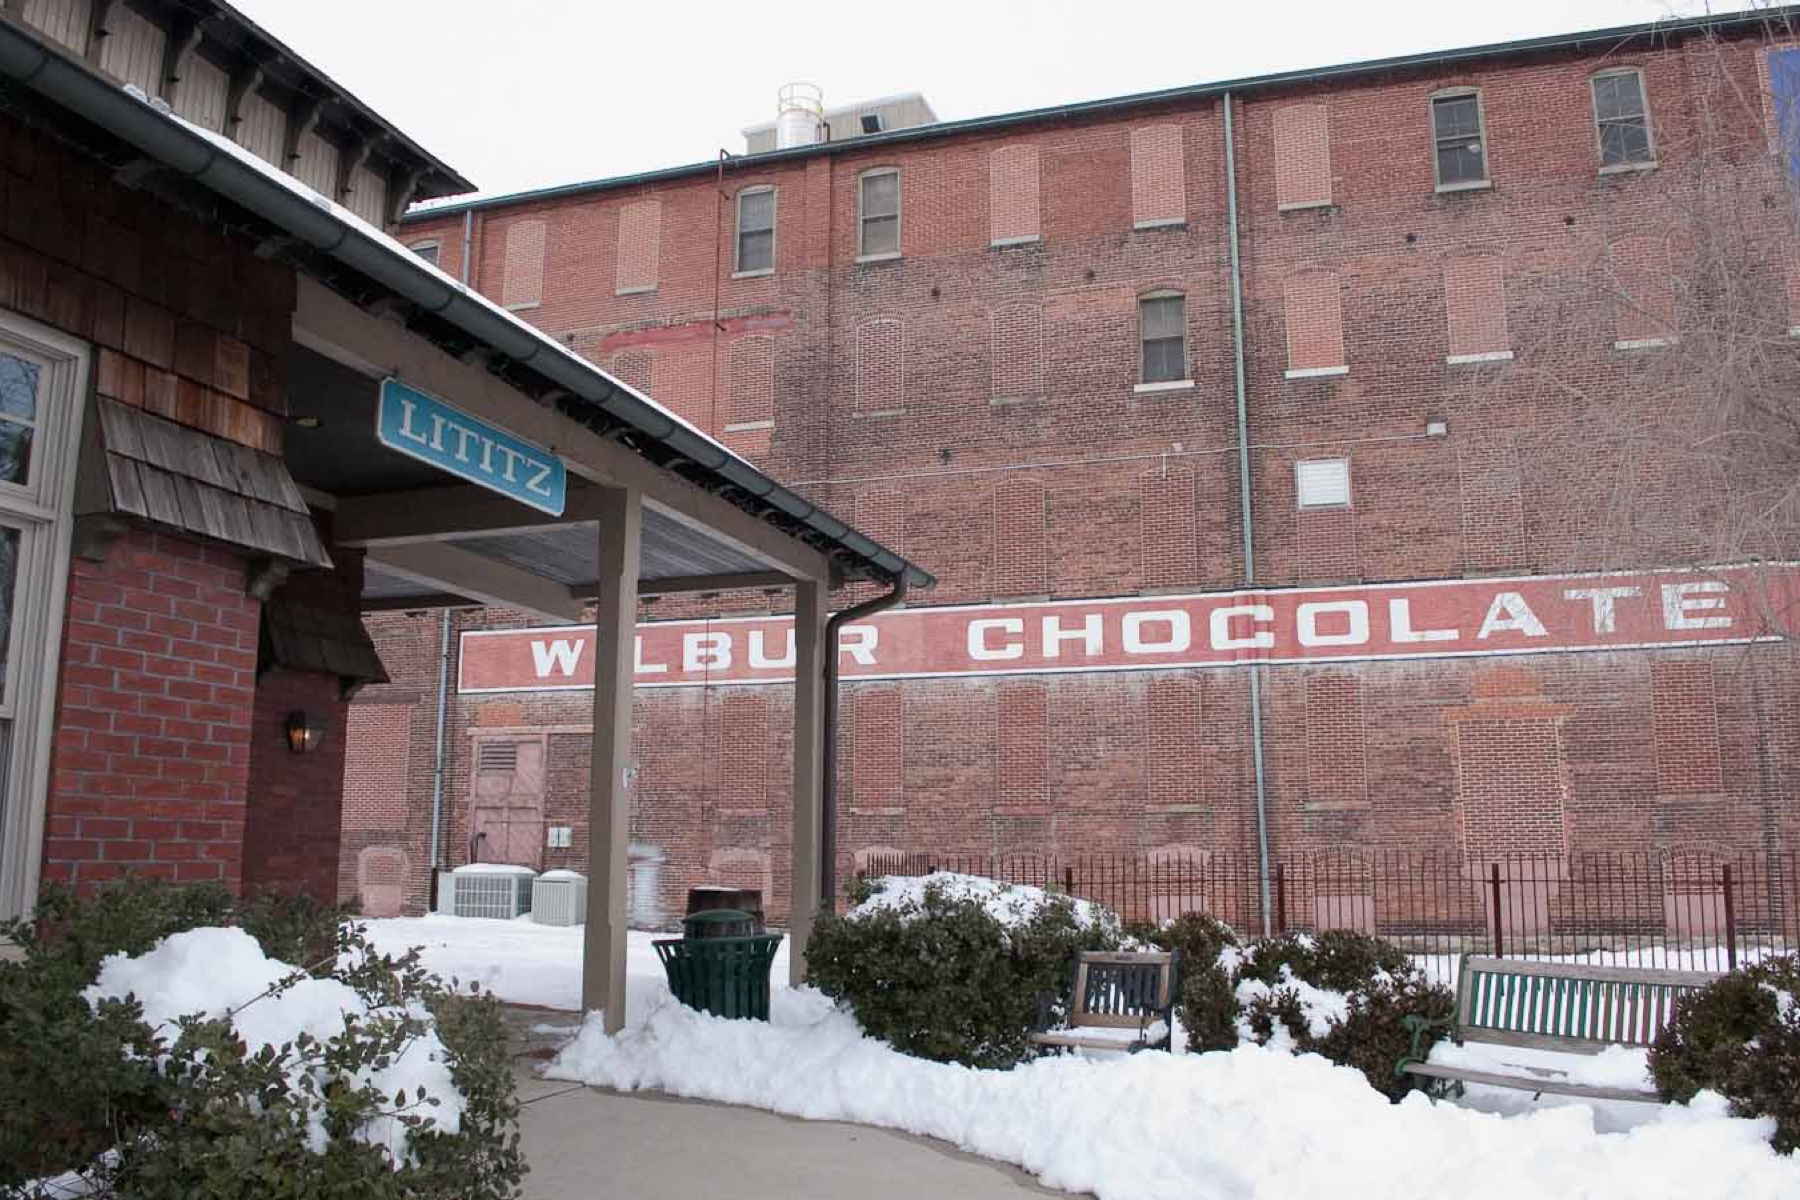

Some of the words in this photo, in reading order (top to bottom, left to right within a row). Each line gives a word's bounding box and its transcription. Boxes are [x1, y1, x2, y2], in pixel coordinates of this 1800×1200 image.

[399, 399, 552, 497] LITITZ
[530, 624, 879, 678] WLBUR
[967, 580, 1733, 661] CHOCOLATE
